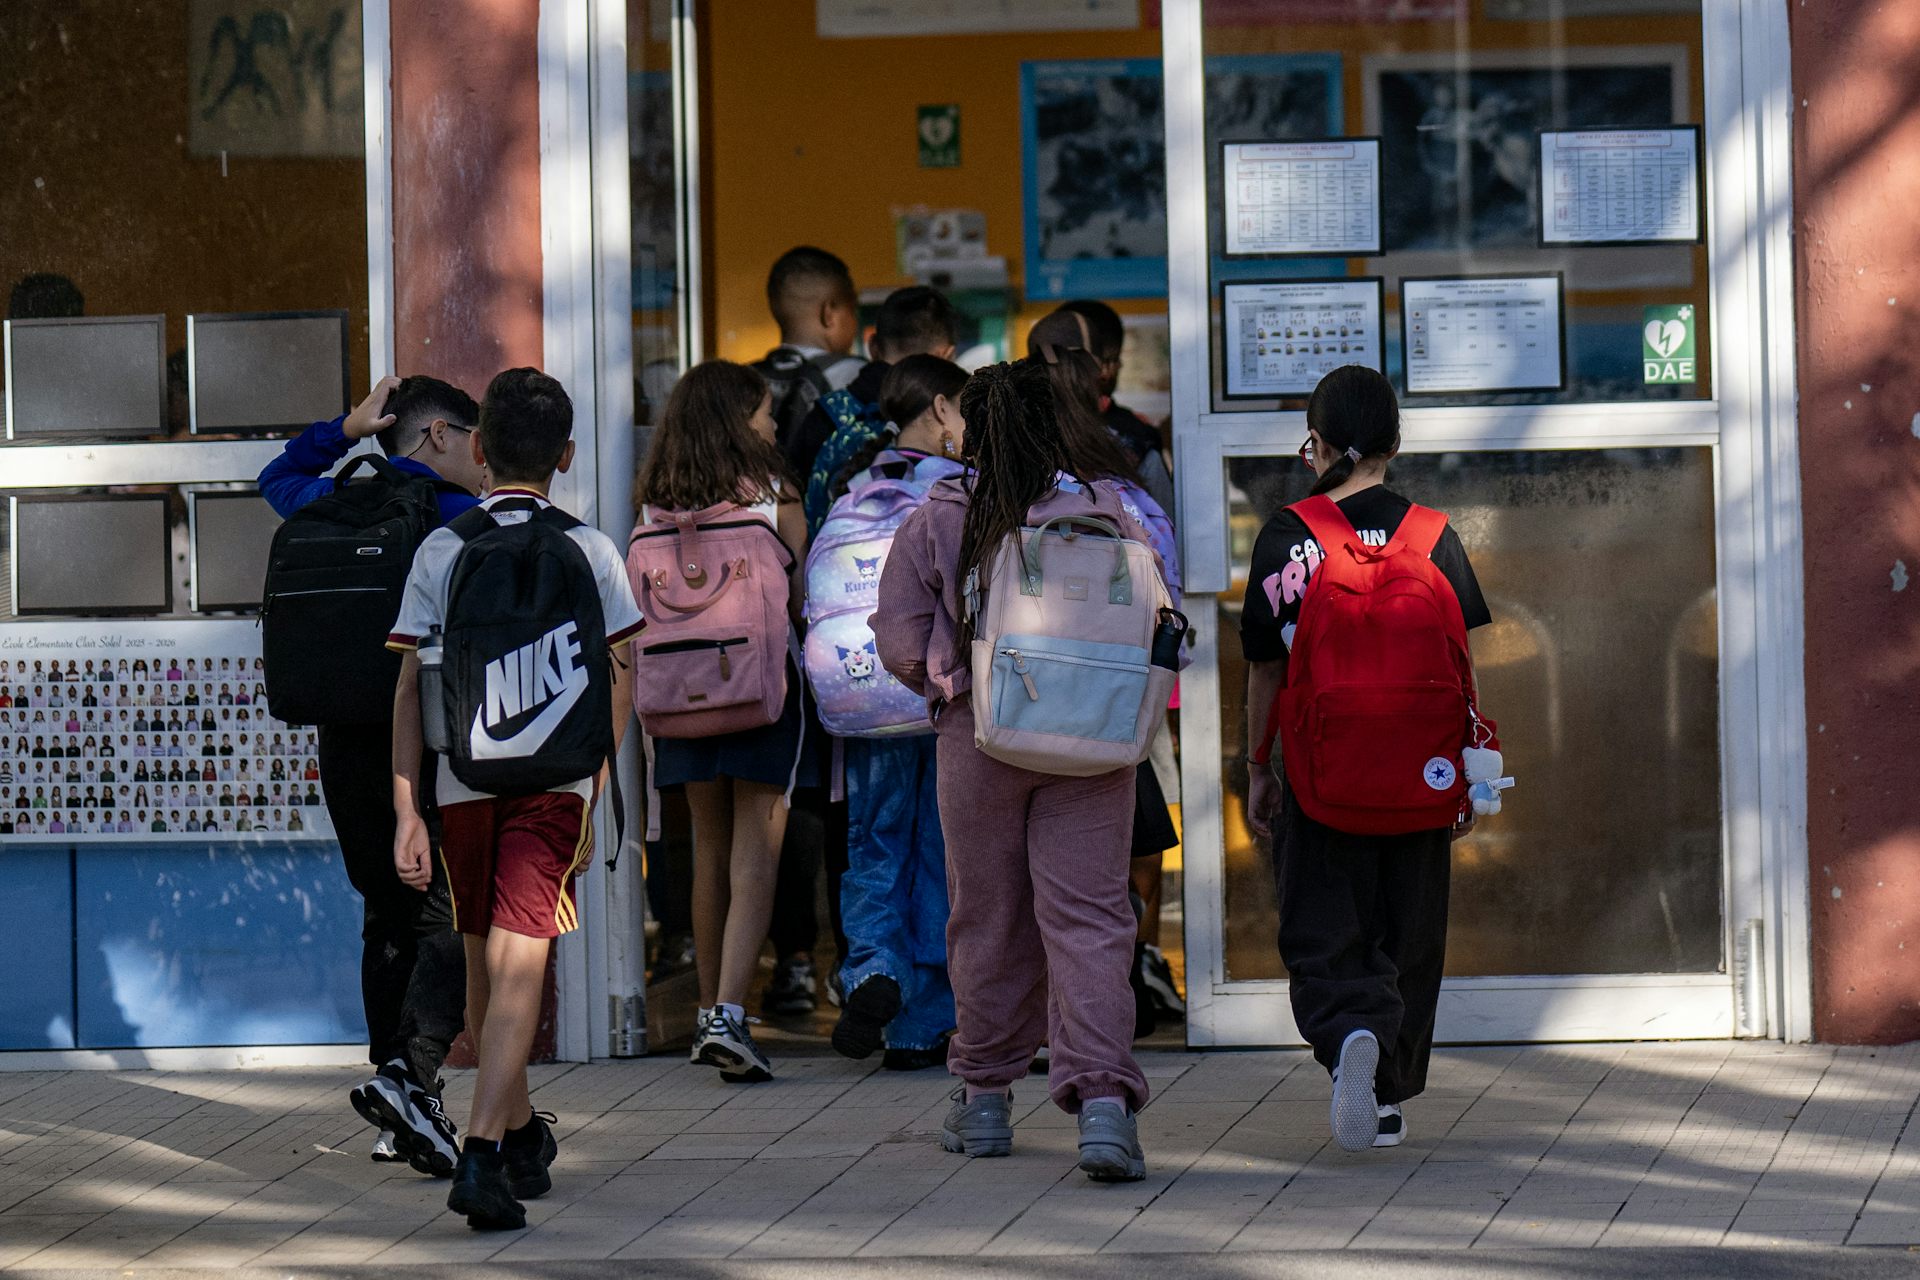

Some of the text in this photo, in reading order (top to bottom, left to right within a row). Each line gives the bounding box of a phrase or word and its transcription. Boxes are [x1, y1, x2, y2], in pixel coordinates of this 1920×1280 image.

[1644, 362, 1692, 381] DAE
[844, 580, 877, 593] Kuro
[486, 620, 587, 728] NIKE
